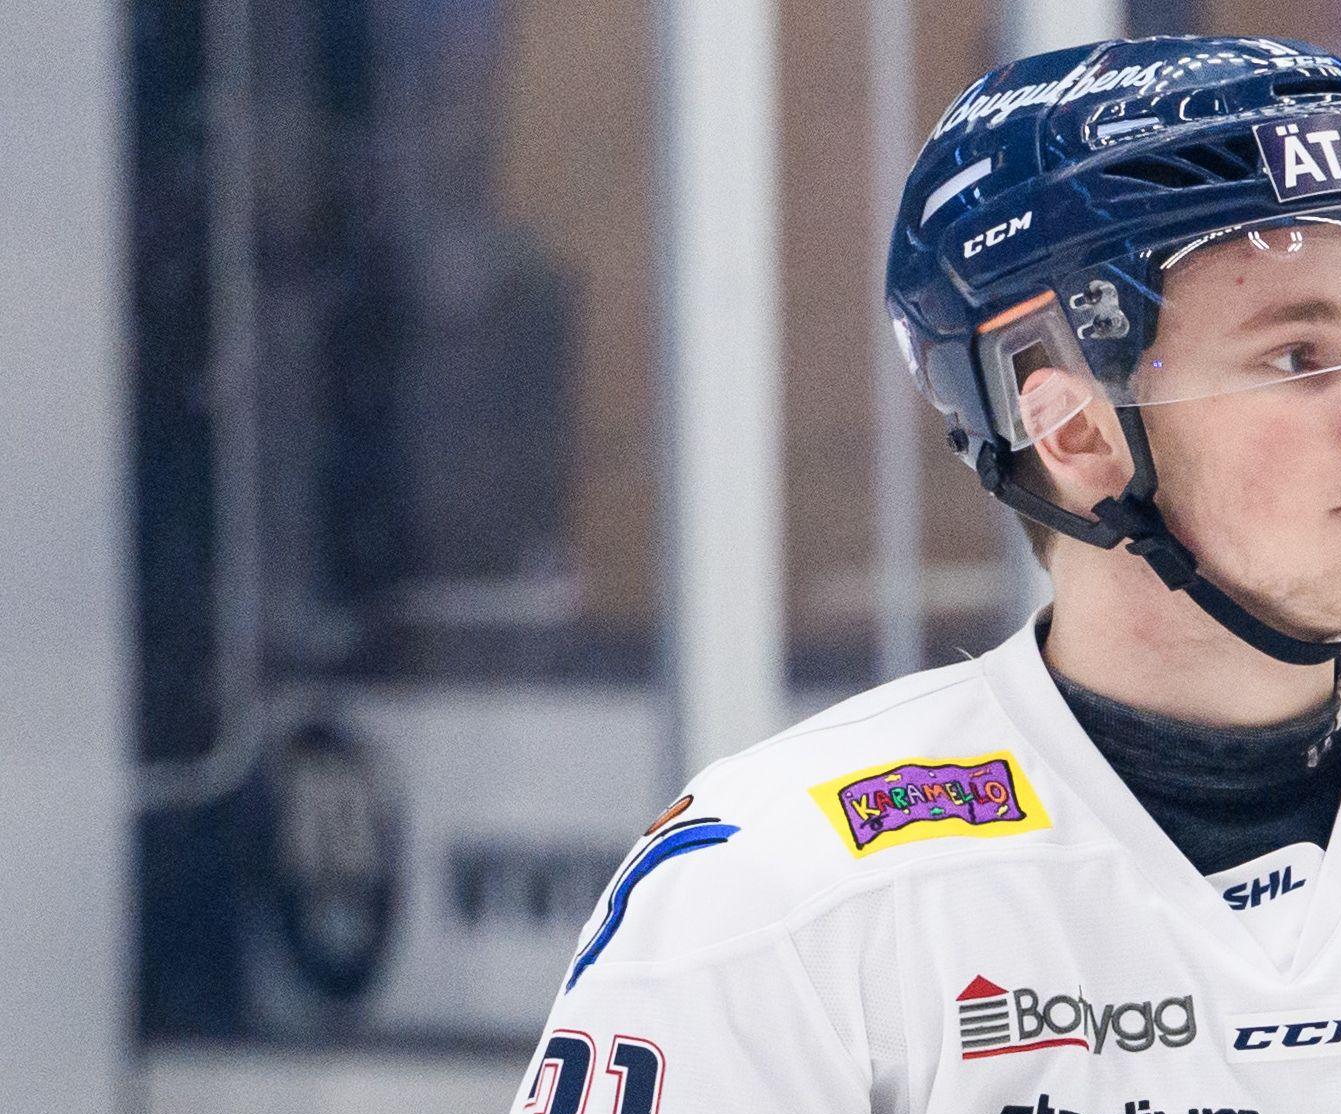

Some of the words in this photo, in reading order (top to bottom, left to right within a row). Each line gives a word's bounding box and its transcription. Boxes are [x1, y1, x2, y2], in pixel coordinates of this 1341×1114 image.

[963, 211, 1032, 261] CCM
[852, 780, 1009, 821] KARAMELLO
[1222, 864, 1306, 910] SHL
